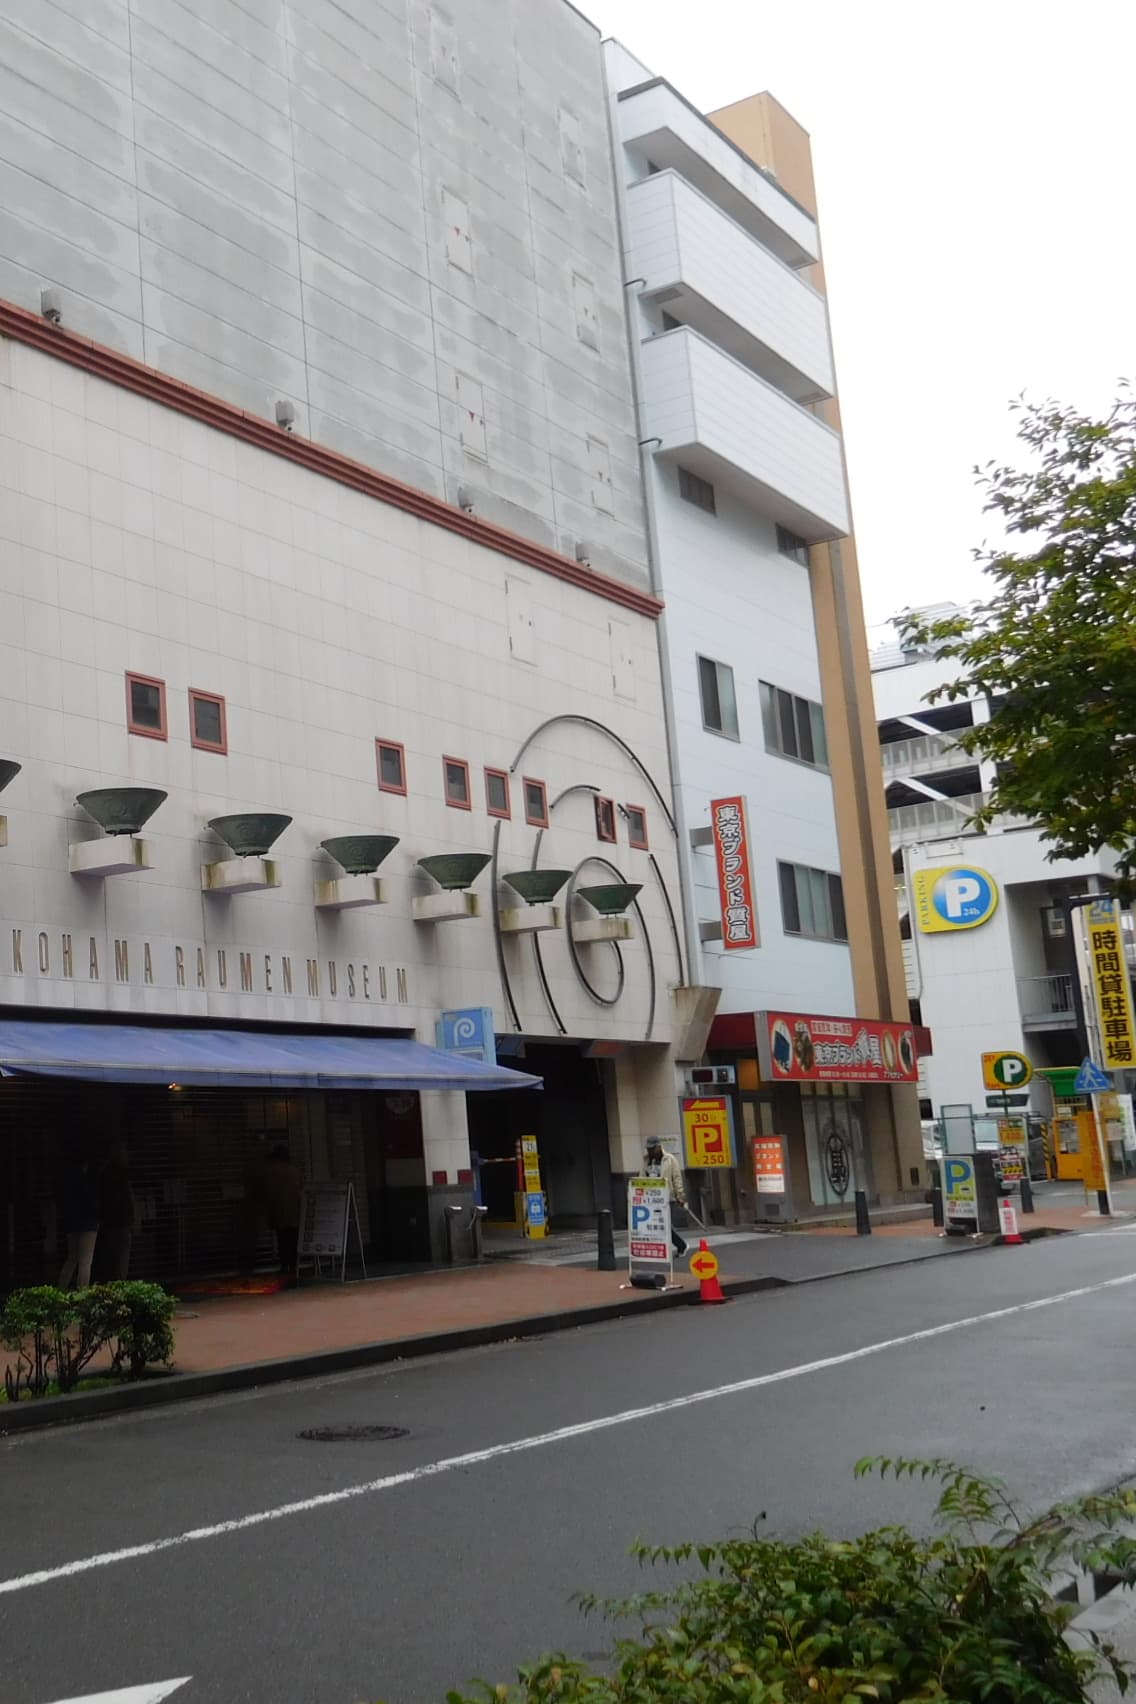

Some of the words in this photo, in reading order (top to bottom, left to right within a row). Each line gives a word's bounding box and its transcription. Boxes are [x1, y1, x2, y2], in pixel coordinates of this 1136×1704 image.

[717, 805, 751, 941] 東京ブランド質屋
[944, 878, 981, 917] P
[175, 945, 294, 995] RAUMEN
[306, 958, 409, 1003] MUSEUM
[1092, 930, 1133, 1063] 時間貸駐車場
[1002, 1058, 1023, 1083] P
[695, 1127, 719, 1153] P
[945, 1160, 971, 1194] P
[632, 1205, 650, 1231] P
